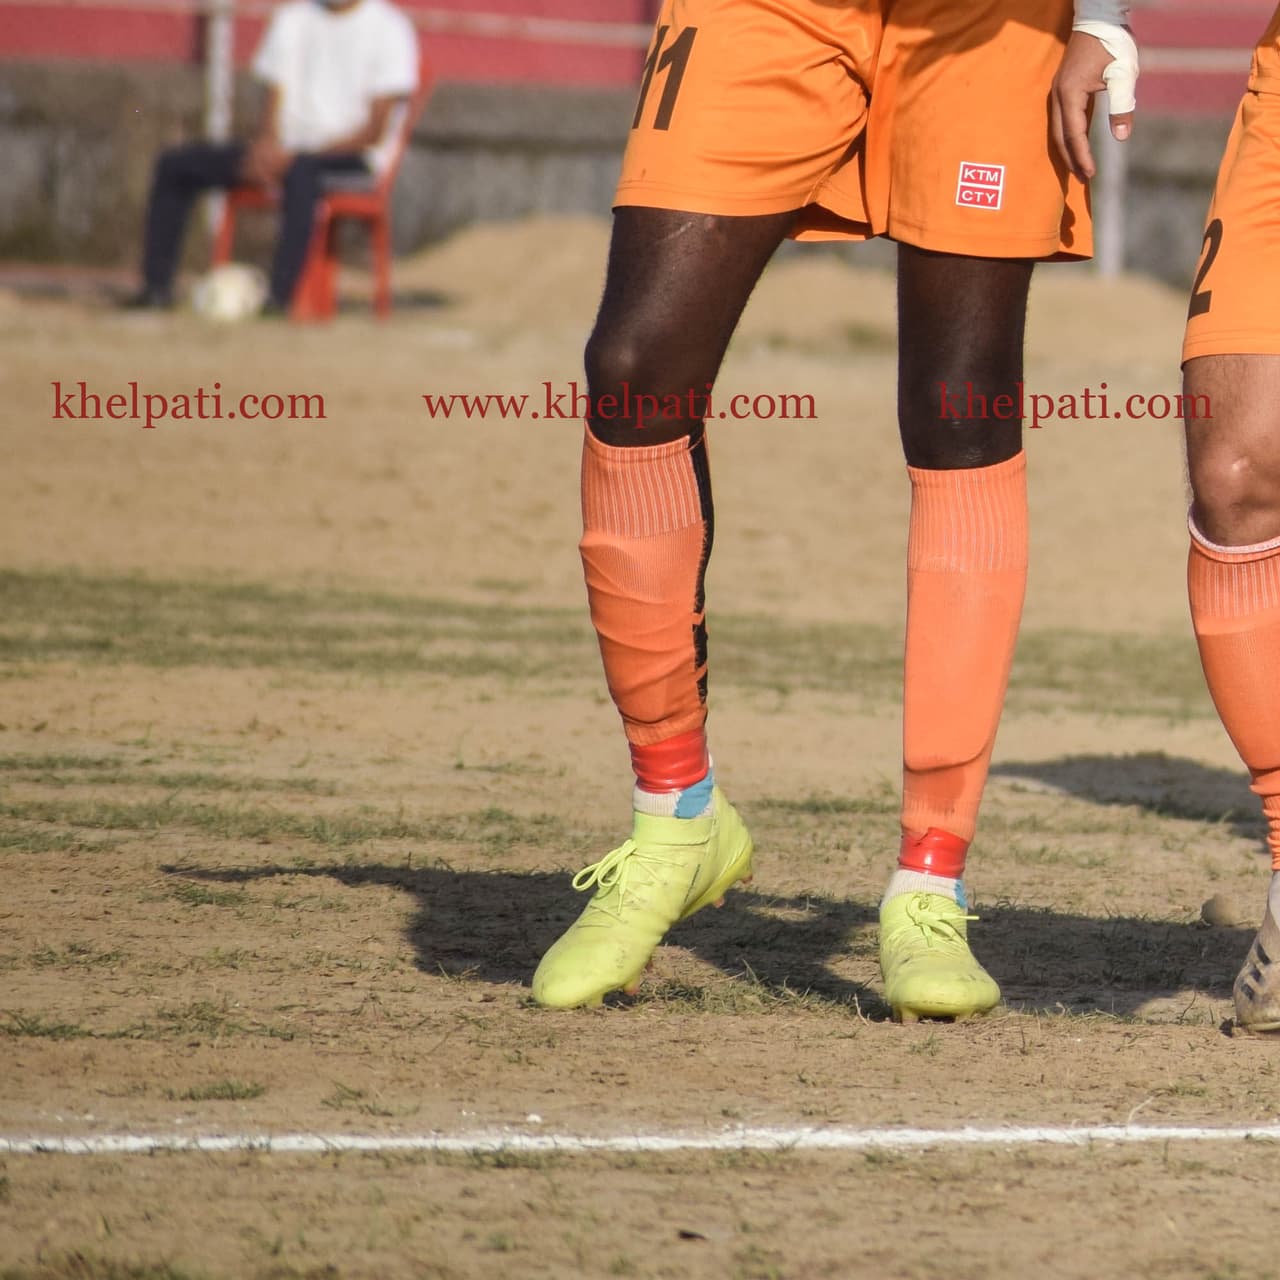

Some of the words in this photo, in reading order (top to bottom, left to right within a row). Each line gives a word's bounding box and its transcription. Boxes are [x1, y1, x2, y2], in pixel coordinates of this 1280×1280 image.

[632, 25, 698, 131] 11
[964, 168, 998, 183] KTM
[961, 190, 996, 204] CTY
